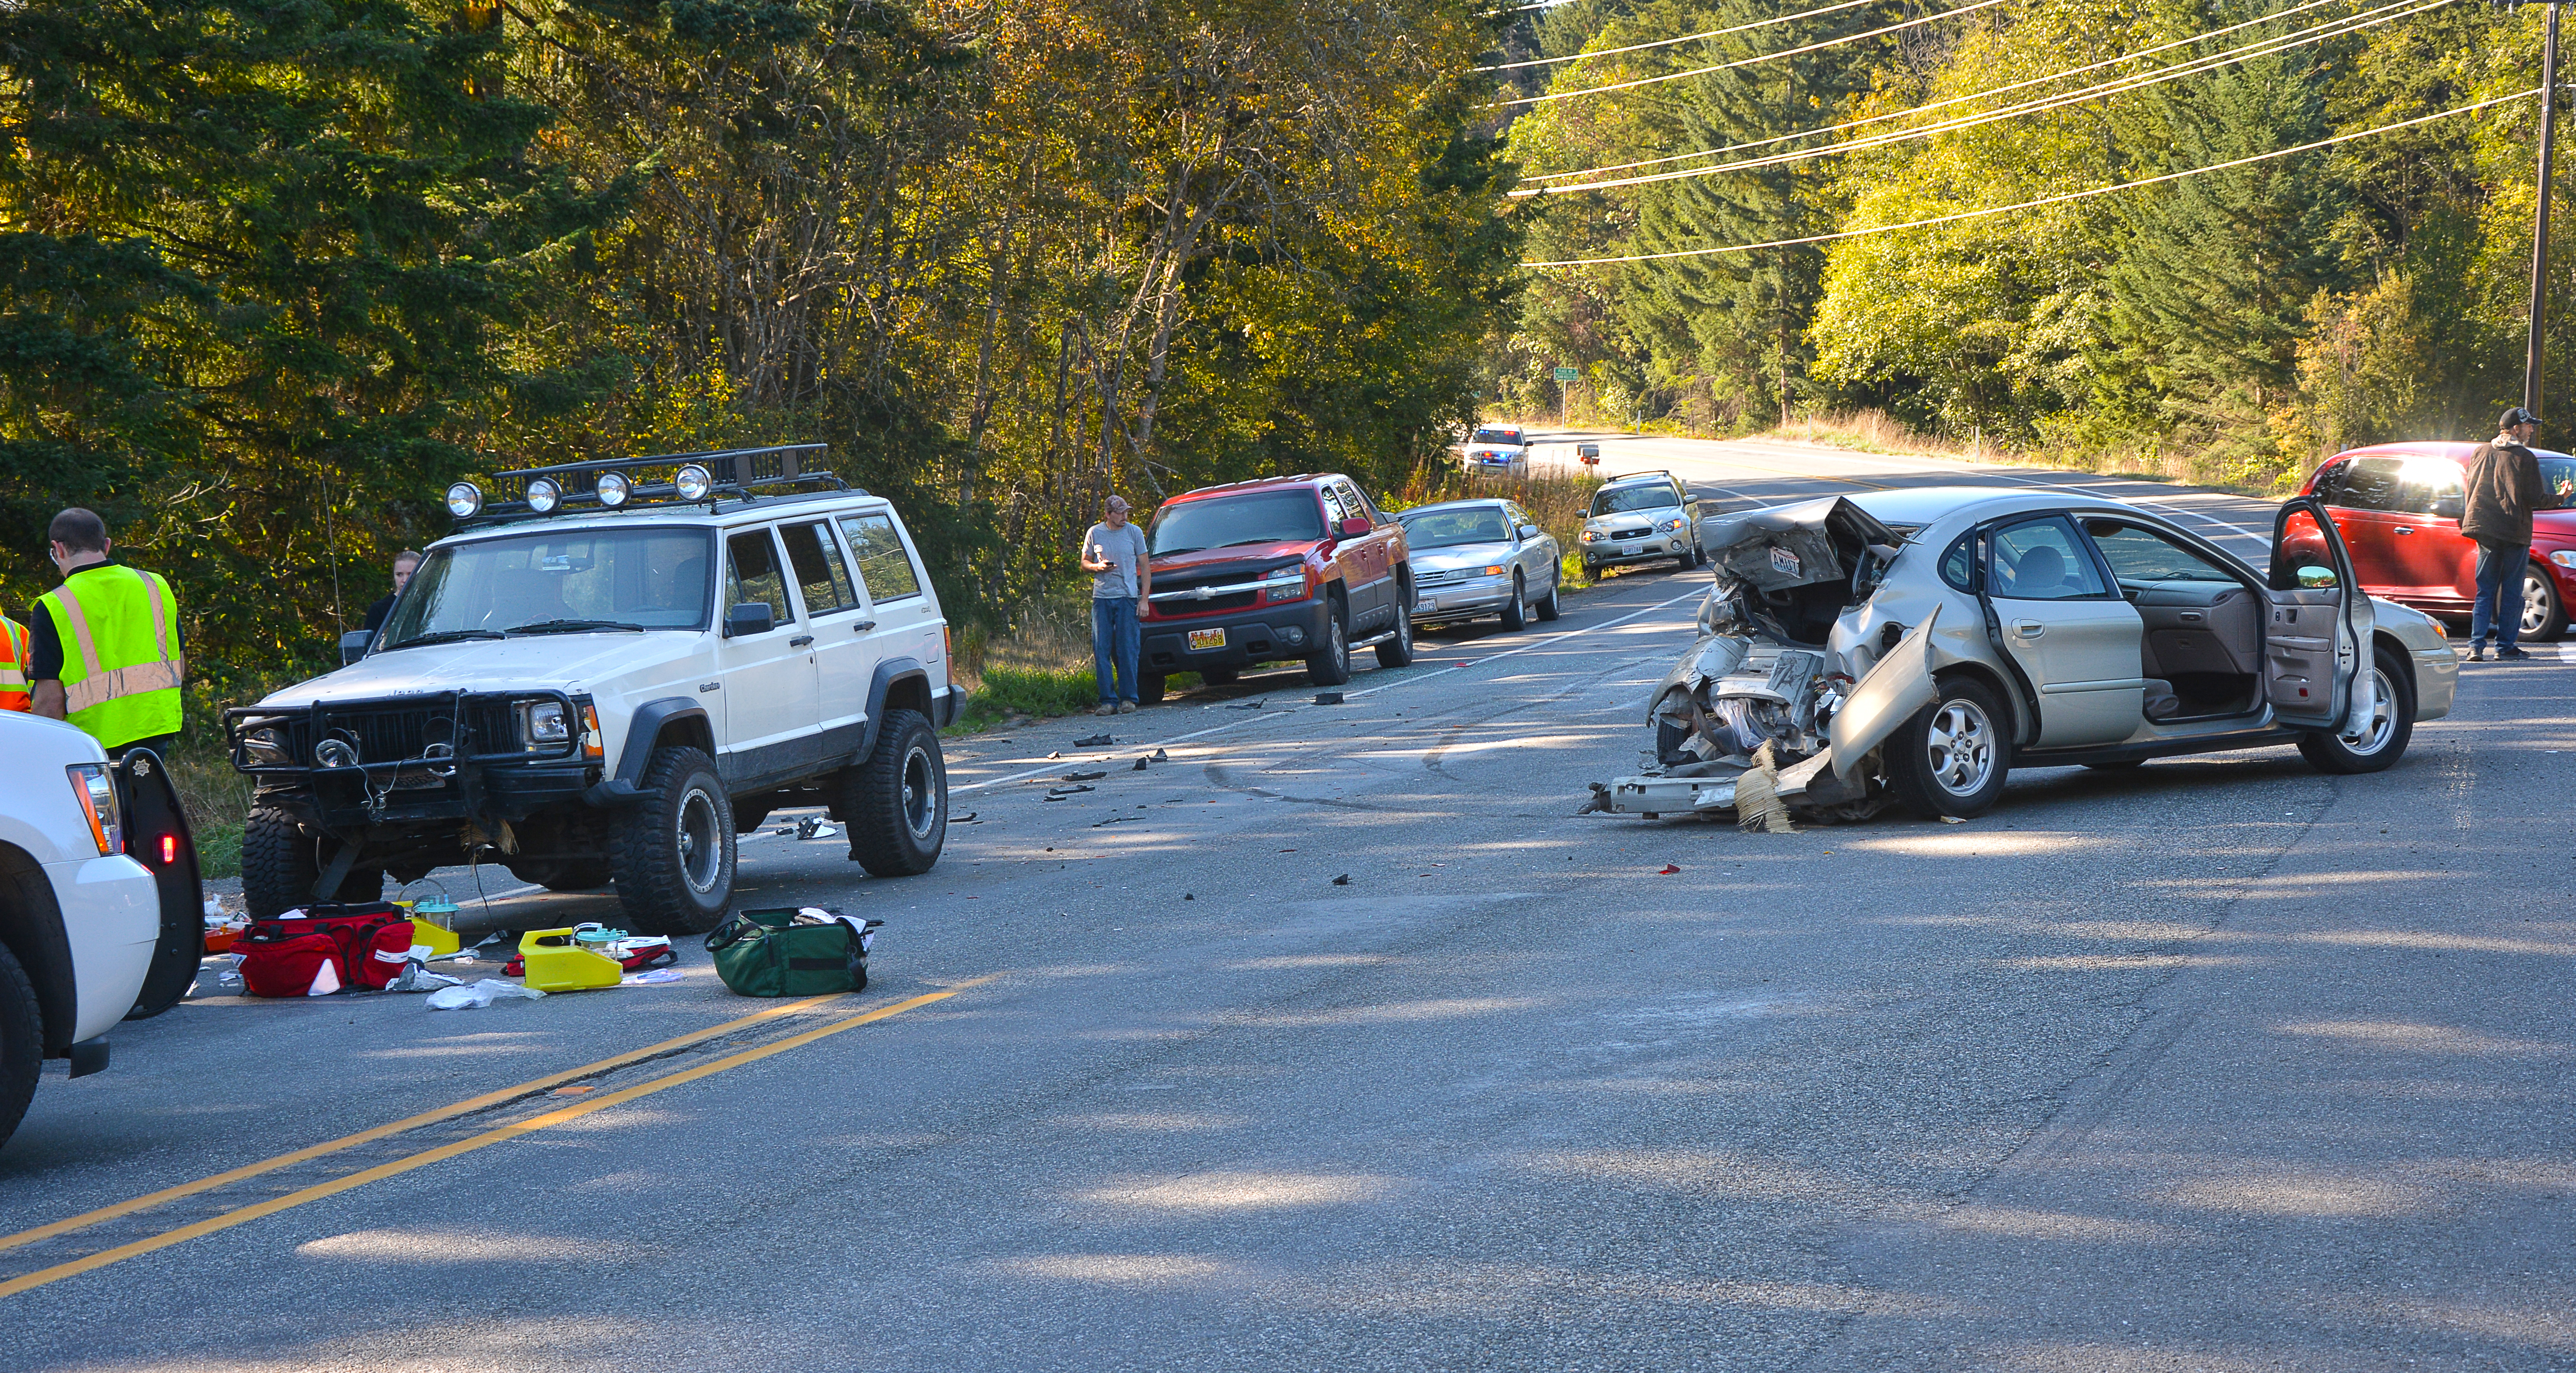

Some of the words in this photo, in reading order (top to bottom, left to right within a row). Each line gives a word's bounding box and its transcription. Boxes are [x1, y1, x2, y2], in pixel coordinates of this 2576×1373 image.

[1773, 554, 1799, 572] AMU7
[1412, 602, 1435, 611] K9129
[699, 682, 720, 693] Cherokee
[720, 800, 733, 890] BIGHORN
